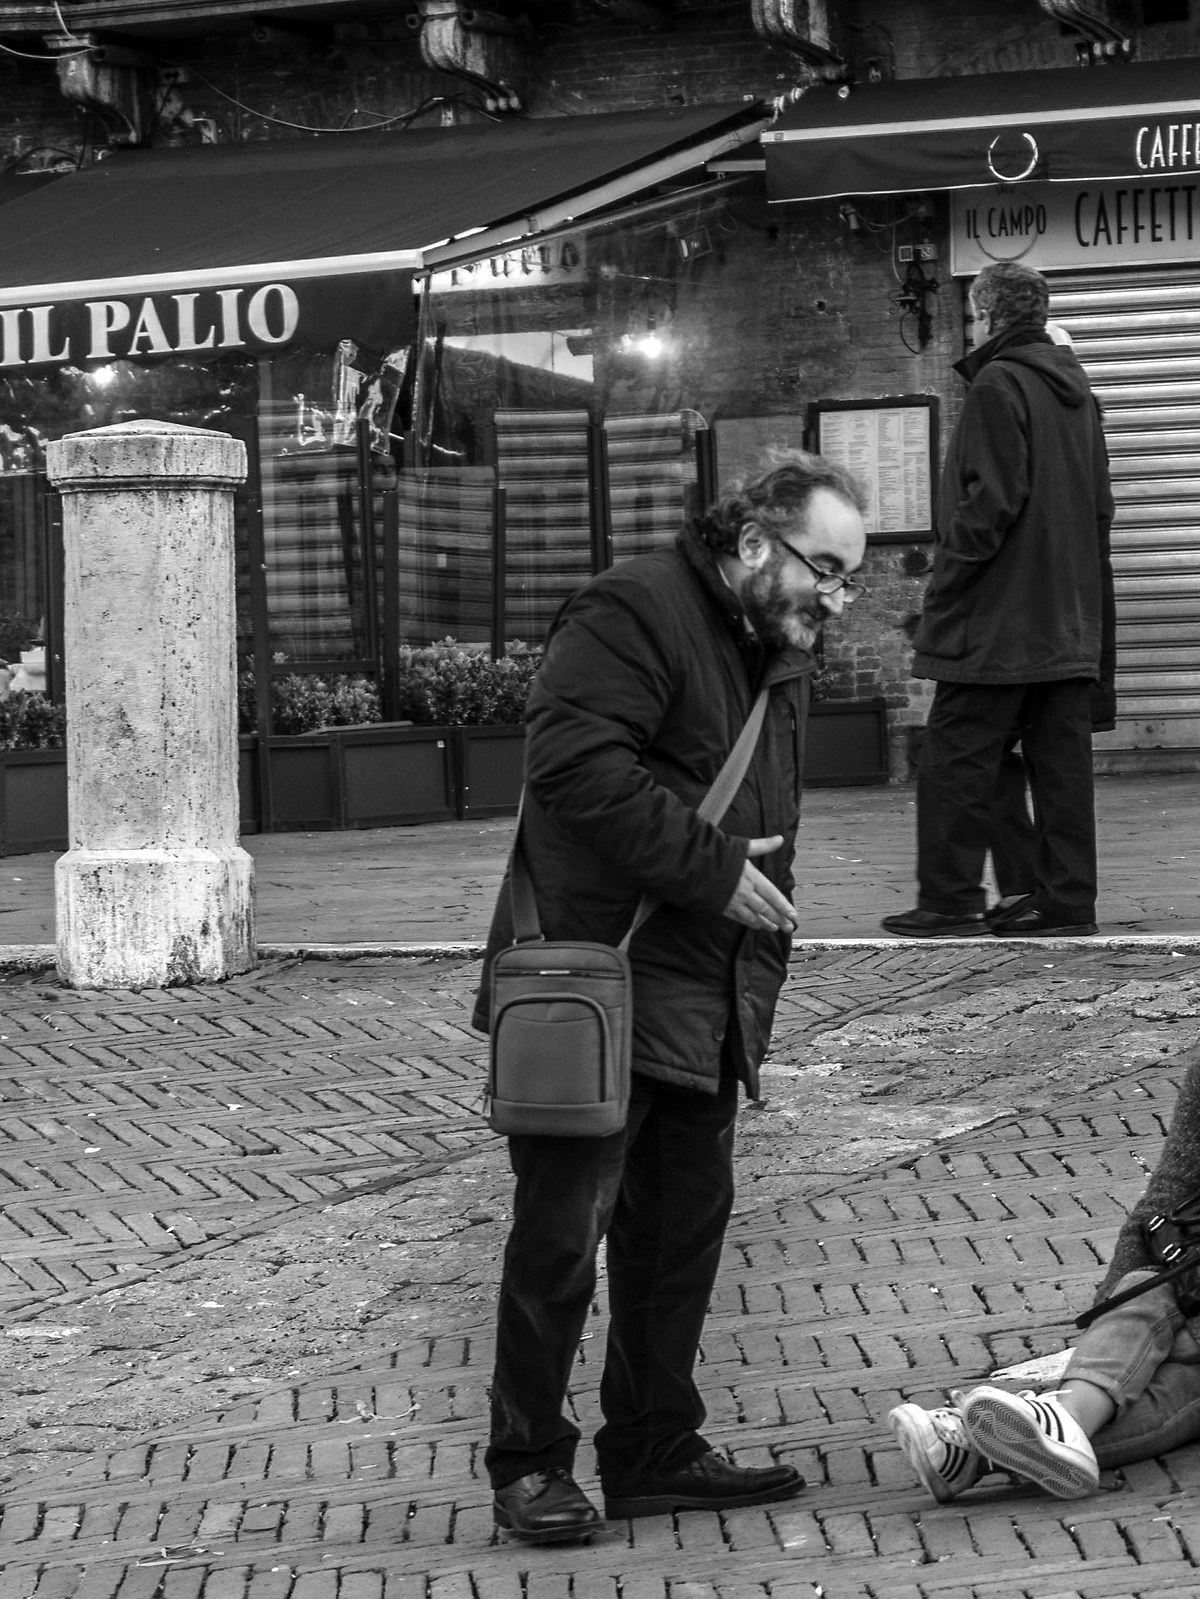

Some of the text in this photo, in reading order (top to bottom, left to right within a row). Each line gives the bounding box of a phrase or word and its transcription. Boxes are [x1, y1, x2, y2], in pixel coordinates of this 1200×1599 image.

[966, 204, 1047, 239] IL CAMPO
[0, 283, 299, 367] IL PALIO
